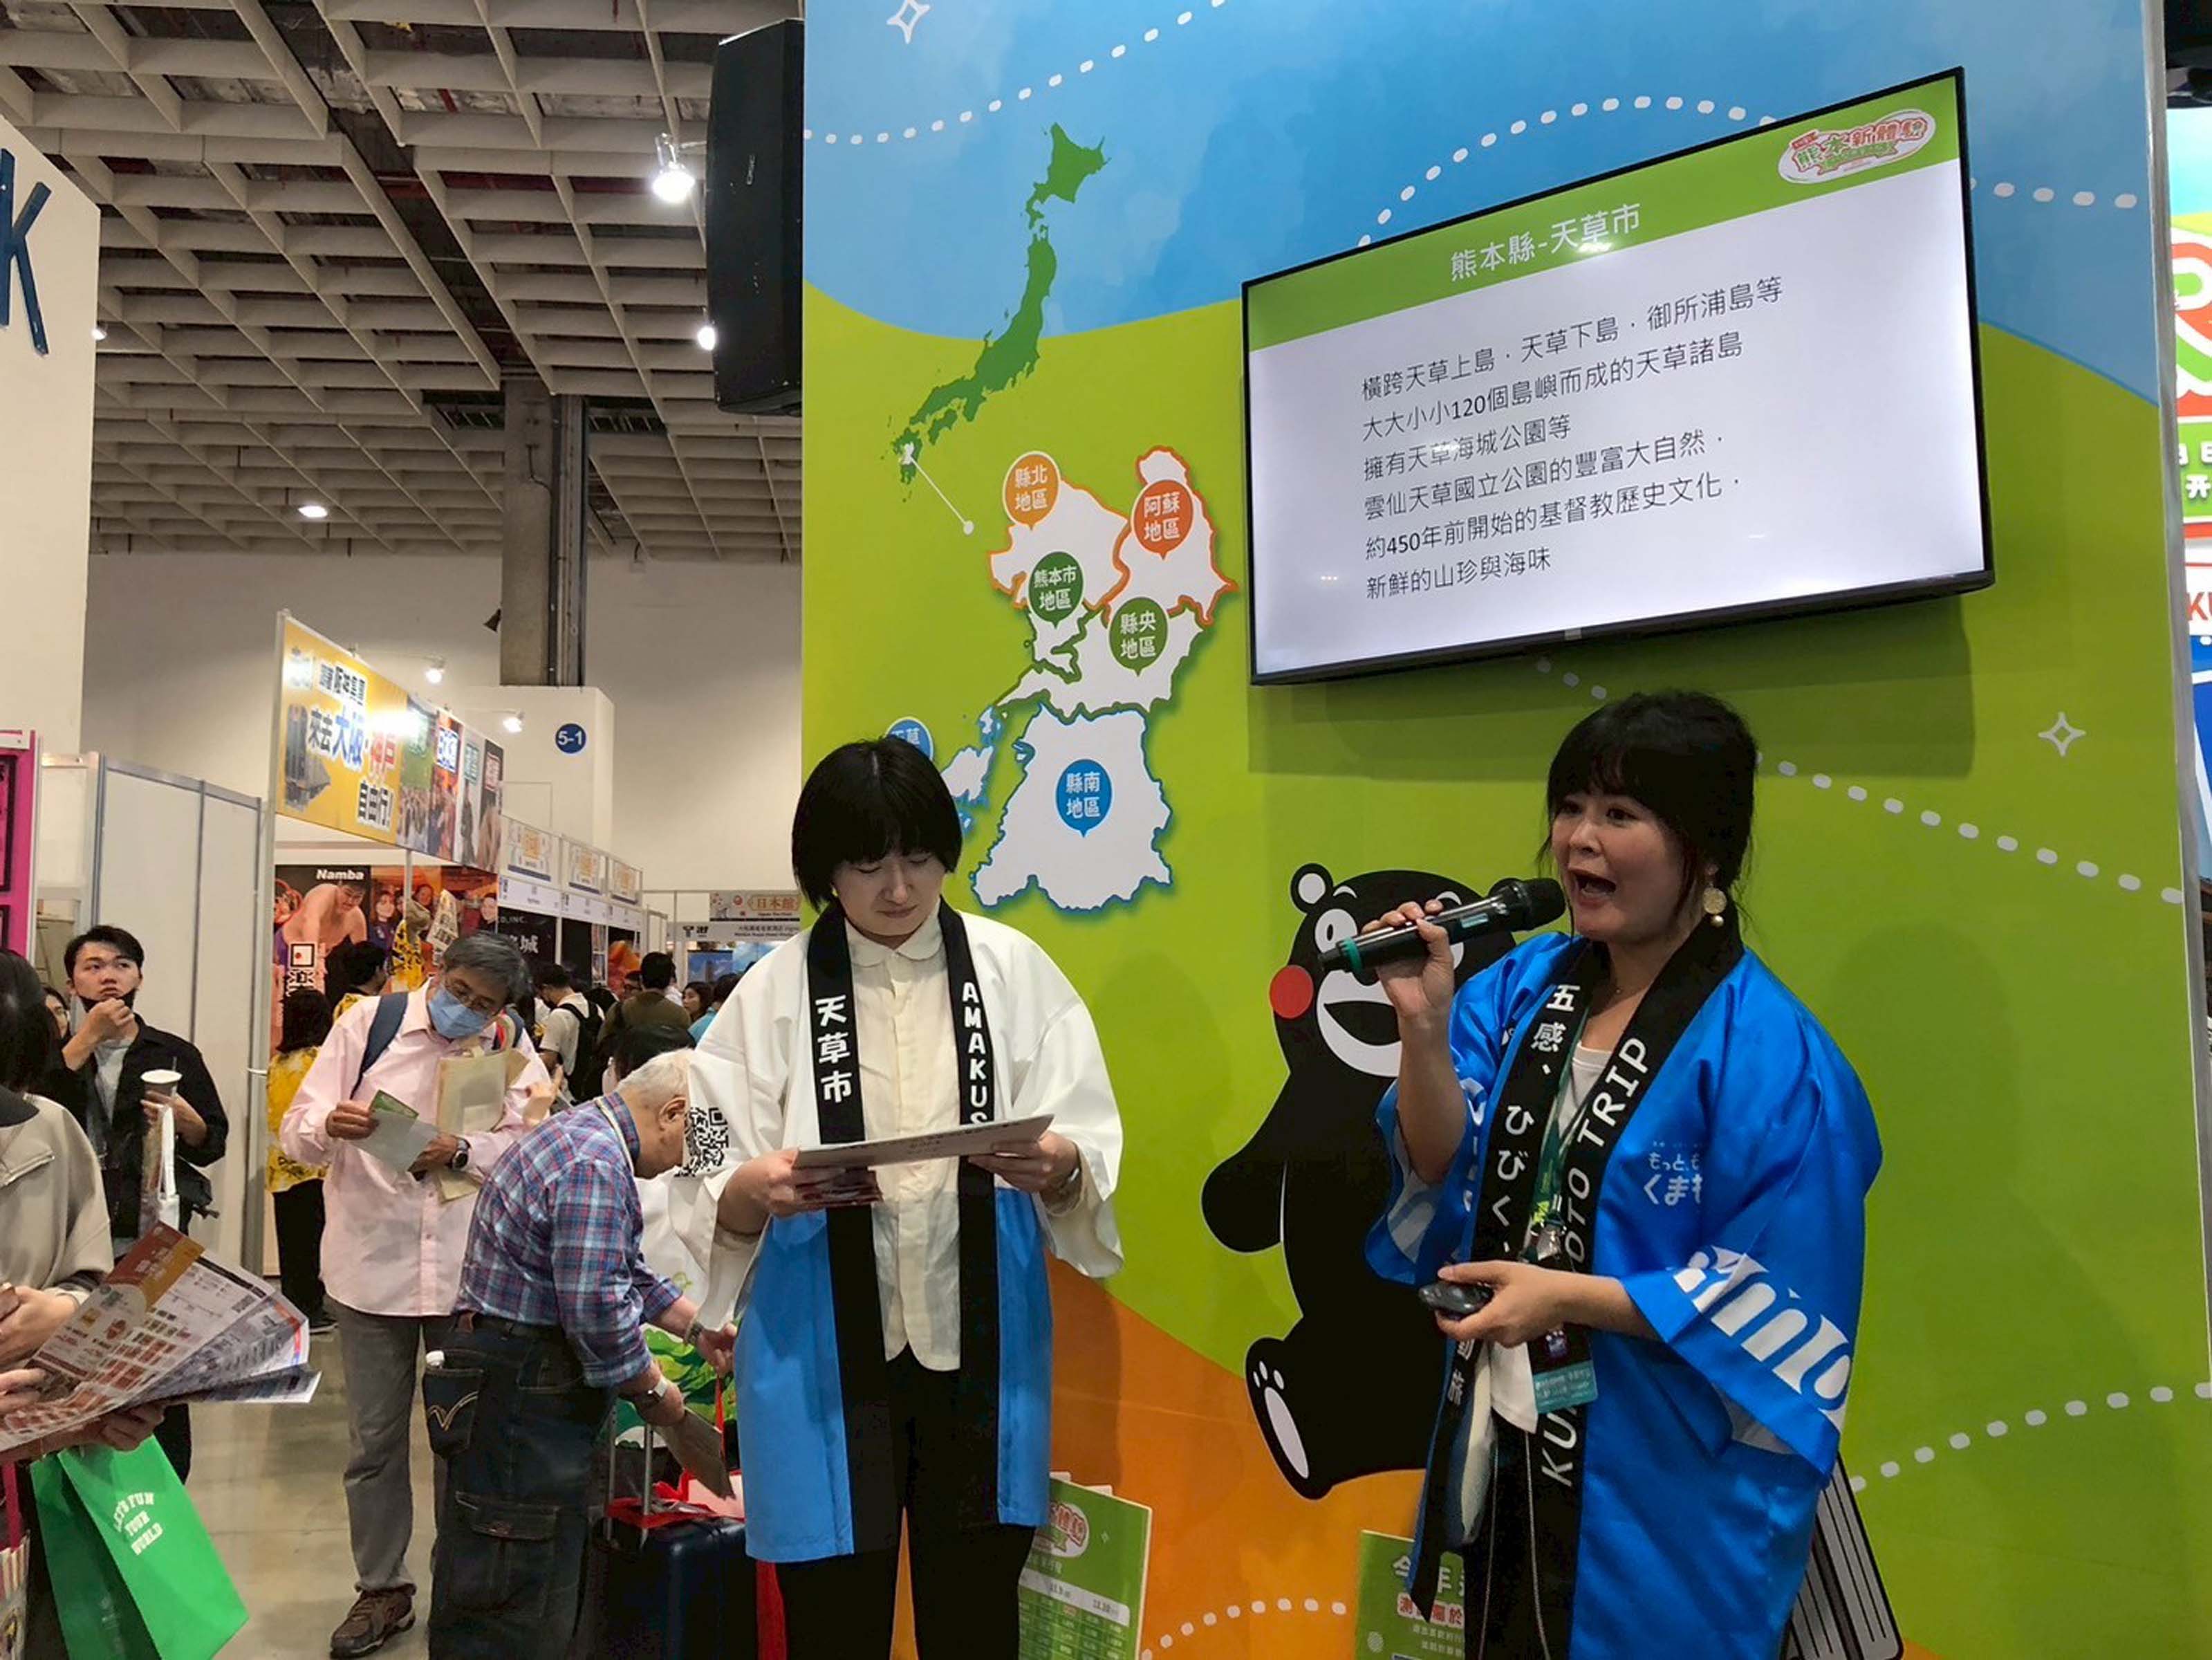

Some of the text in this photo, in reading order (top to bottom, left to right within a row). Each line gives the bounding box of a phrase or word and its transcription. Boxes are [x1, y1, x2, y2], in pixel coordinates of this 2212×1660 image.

[1015, 465, 1048, 486] 縣北
[1015, 489, 1048, 510] 地區
[1144, 492, 1180, 517] 阿蘇
[1144, 519, 1180, 542] 地區
[1034, 564, 1077, 587] 熊本市
[1366, 547, 1552, 600] 新鮮的山珍與海味
[1039, 589, 1071, 611] 地區
[1120, 611, 1157, 634] 縣央
[1120, 636, 1156, 659] 地區
[557, 730, 583, 746] 5-1
[1066, 772, 1100, 794] 縣南
[1066, 796, 1100, 820] 地區
[316, 869, 364, 880] Namba
[816, 994, 853, 1105] 天草市
[1577, 1038, 1648, 1148] TRIP
[127, 1492, 155, 1509] FUN
